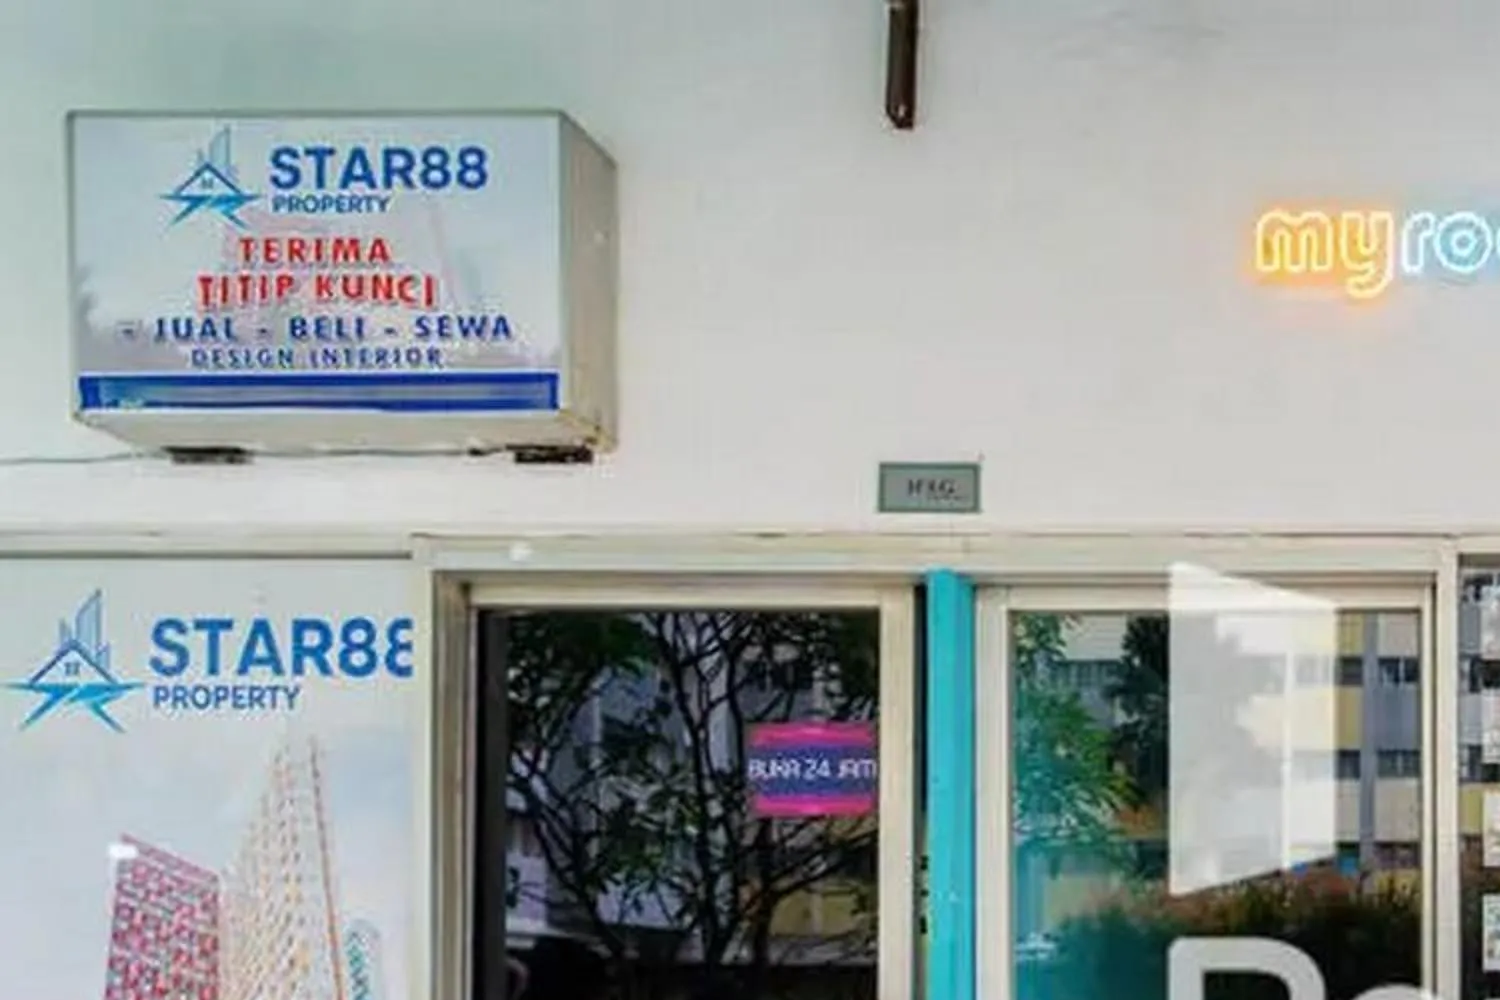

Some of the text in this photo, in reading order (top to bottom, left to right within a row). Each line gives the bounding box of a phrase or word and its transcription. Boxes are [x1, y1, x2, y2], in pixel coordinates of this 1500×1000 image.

[269, 146, 489, 190] STAR88
[271, 195, 389, 214] PROPERTY
[238, 237, 391, 263] TERIMA
[198, 274, 438, 307] TITIP KUNCI
[154, 317, 238, 342] JUAL
[289, 317, 366, 340] BELI
[414, 315, 513, 339] SEWA
[191, 347, 443, 369] DESIGN INTERIOR
[149, 617, 413, 678] STAR88
[152, 686, 301, 709] PROPERTY
